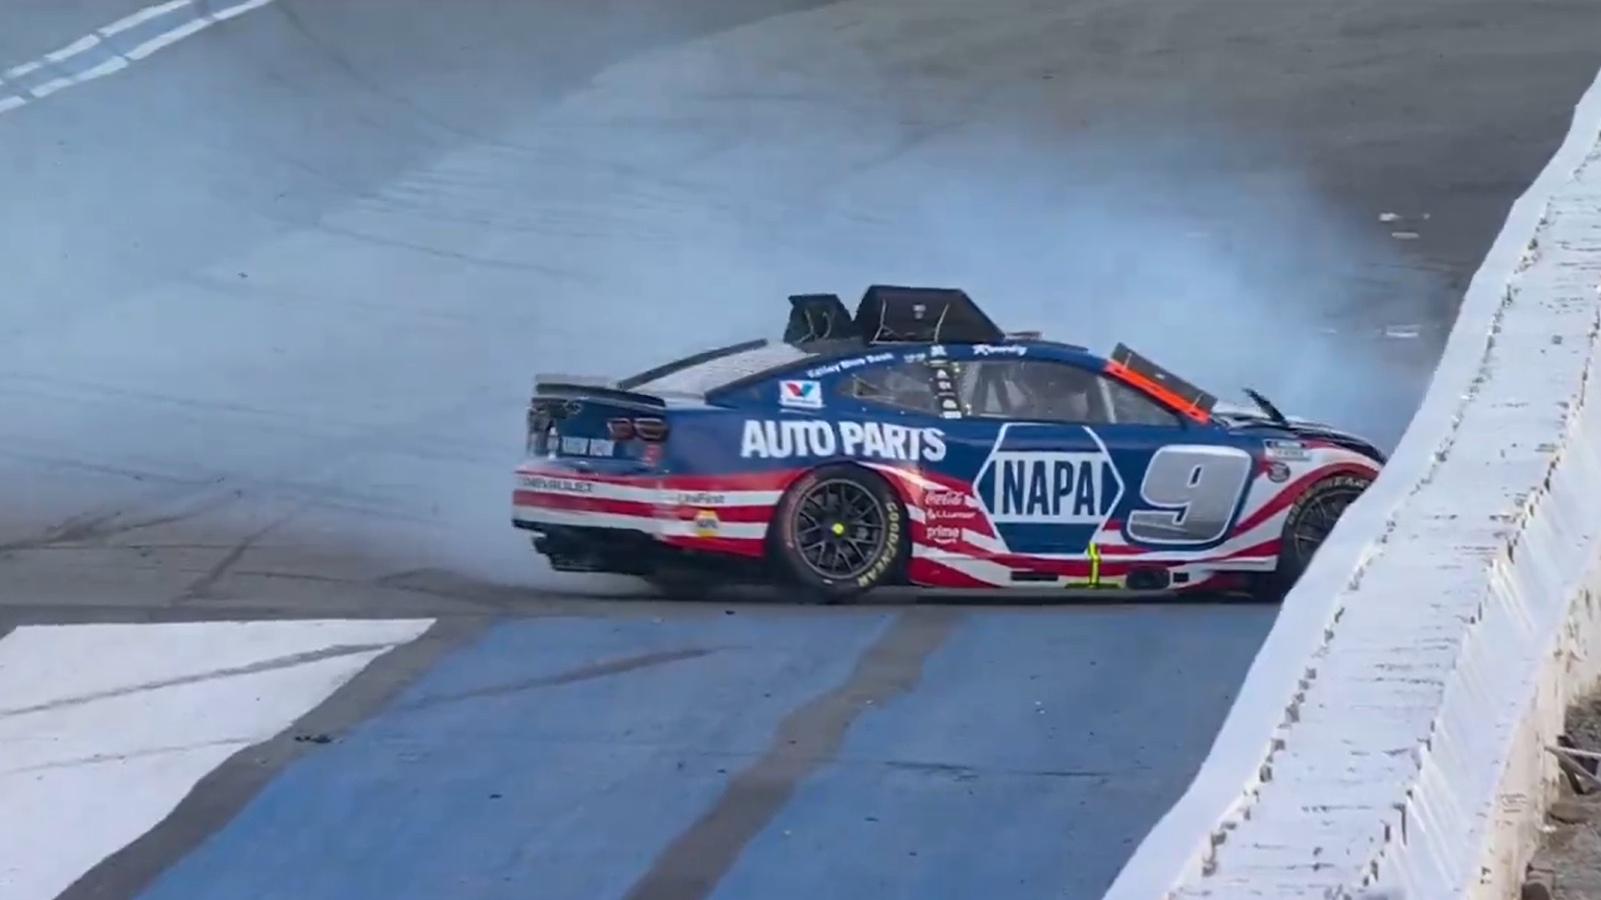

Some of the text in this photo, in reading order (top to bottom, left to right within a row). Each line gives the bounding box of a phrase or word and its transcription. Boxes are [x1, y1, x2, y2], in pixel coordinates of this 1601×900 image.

[740, 419, 947, 462] AUTO PARTS
[1002, 460, 1096, 516] NAPA
[1126, 444, 1252, 545] 9
[857, 502, 900, 587] GOODYEAR
